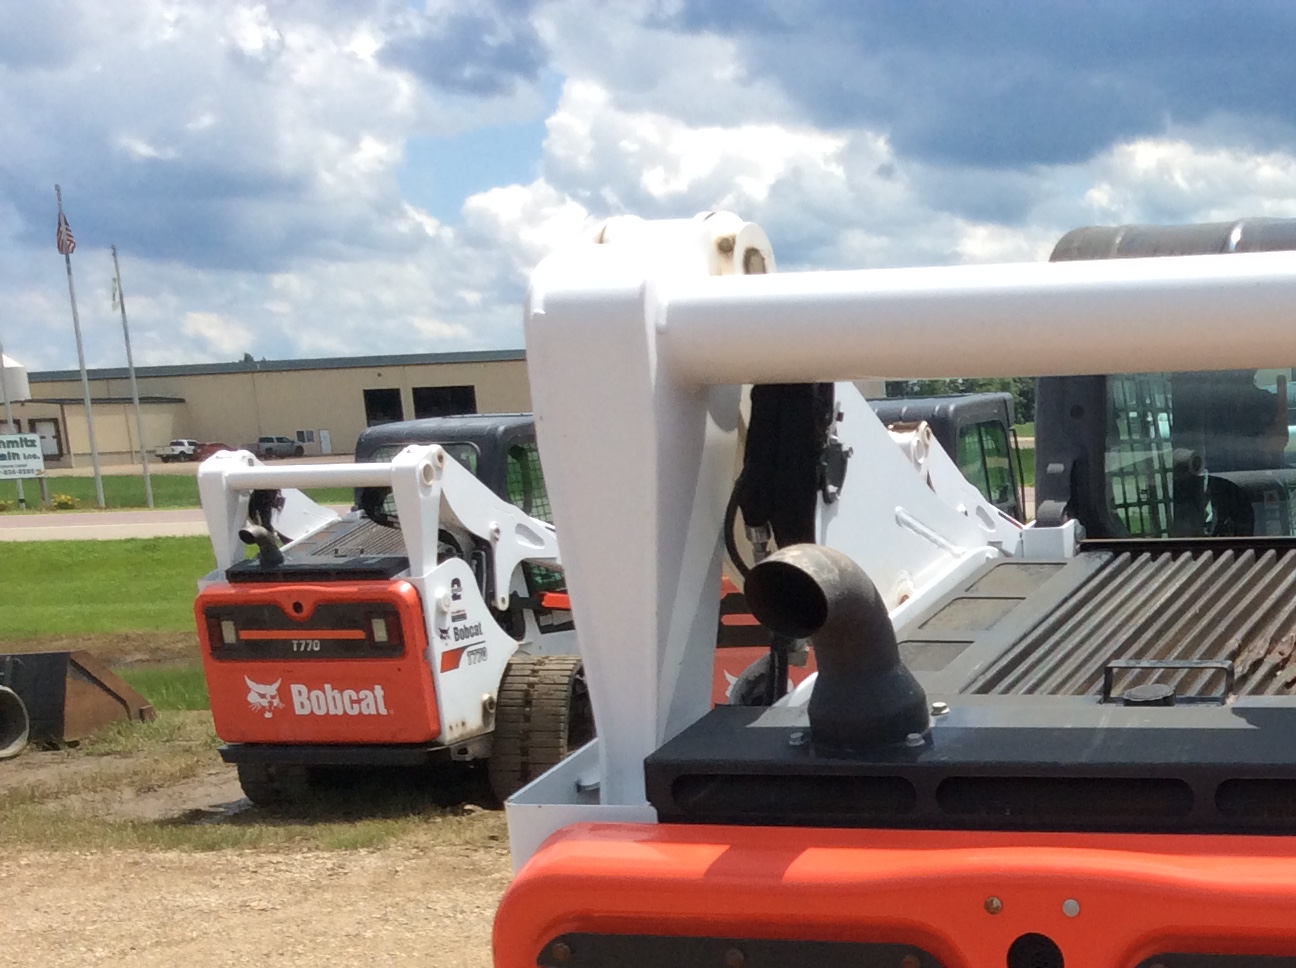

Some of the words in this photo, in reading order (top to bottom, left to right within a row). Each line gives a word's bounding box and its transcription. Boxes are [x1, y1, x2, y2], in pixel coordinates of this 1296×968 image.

[453, 621, 483, 642] Bobcat
[291, 639, 321, 652] T770
[466, 646, 488, 666] T770
[290, 683, 388, 716] Bobcat
